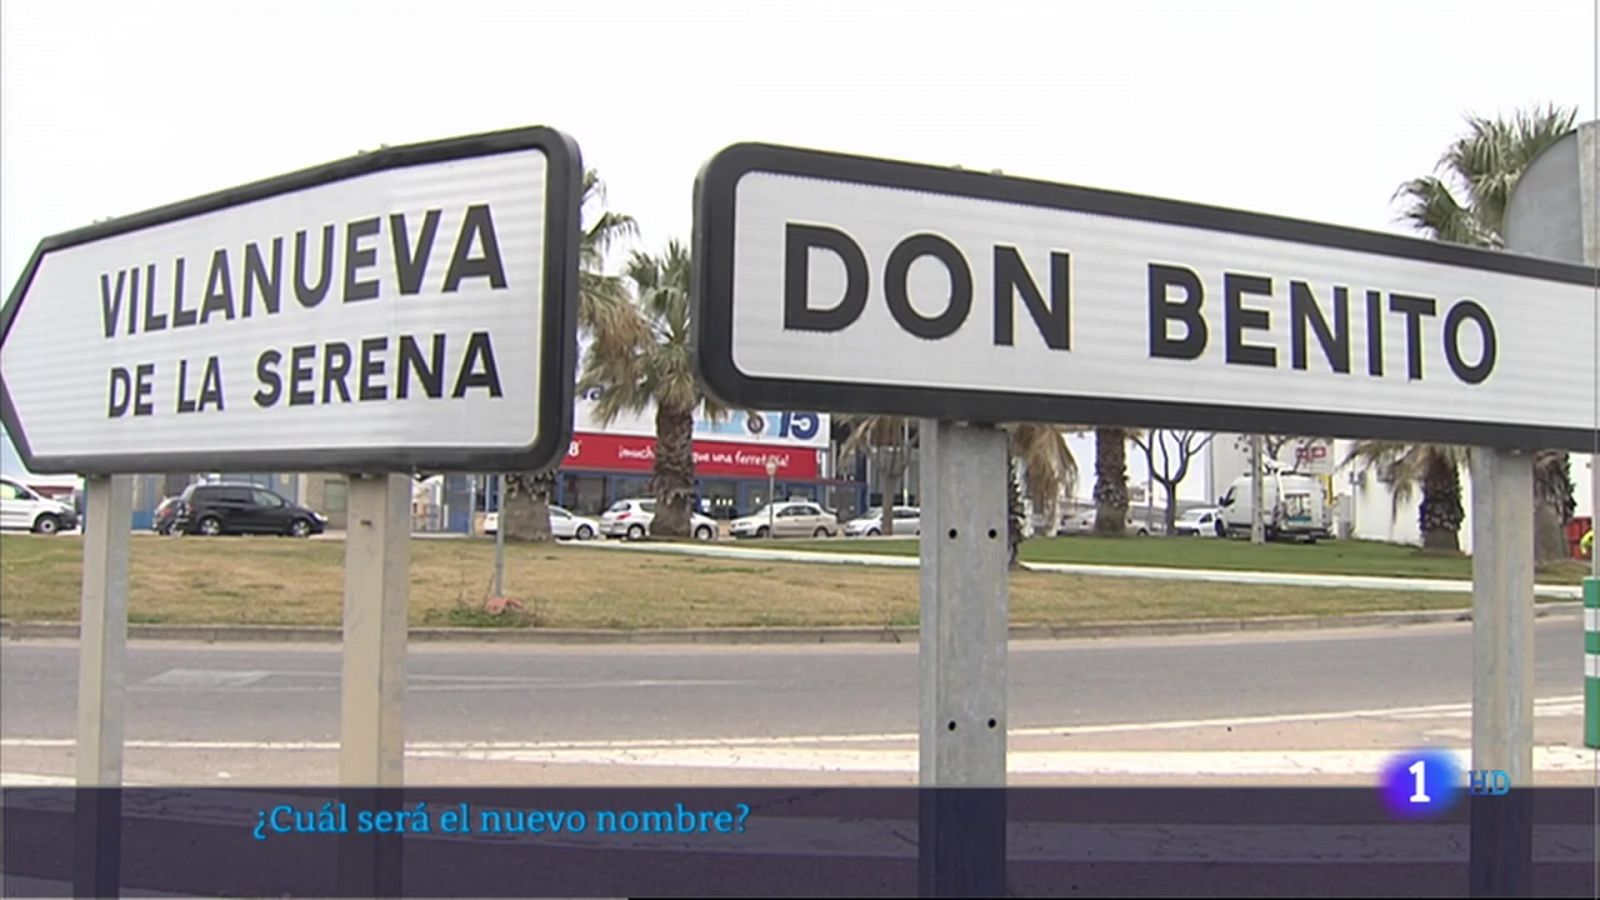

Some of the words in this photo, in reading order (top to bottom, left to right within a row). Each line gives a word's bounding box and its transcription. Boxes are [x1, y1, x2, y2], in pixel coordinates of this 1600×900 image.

[101, 204, 508, 338] VILLANUEVA
[783, 222, 1071, 352] DON
[1147, 263, 1497, 385] BENITO
[108, 363, 155, 418] DE
[177, 356, 225, 413] LA
[254, 331, 503, 408] SERENA
